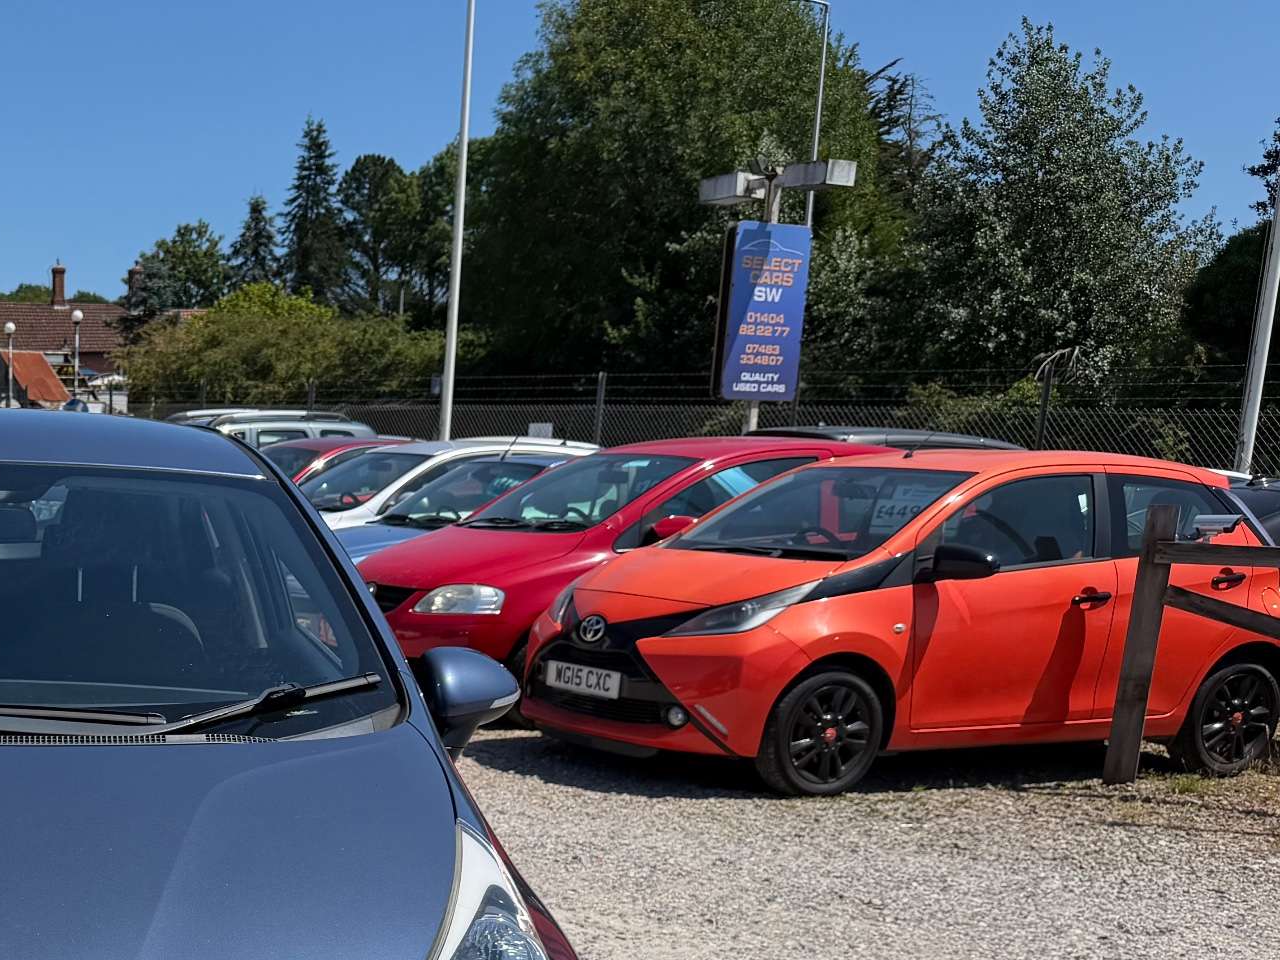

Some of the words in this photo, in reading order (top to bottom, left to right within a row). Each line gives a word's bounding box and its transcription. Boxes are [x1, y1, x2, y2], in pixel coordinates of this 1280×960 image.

[742, 255, 803, 272] SELECT
[751, 271, 794, 287] CARS
[753, 286, 783, 303] SW
[746, 312, 785, 324] 01404
[740, 372, 780, 382] QUALITY
[732, 382, 759, 392] USED
[760, 383, 786, 393] CARS
[554, 663, 584, 686] WG15
[585, 670, 612, 692] CXC
